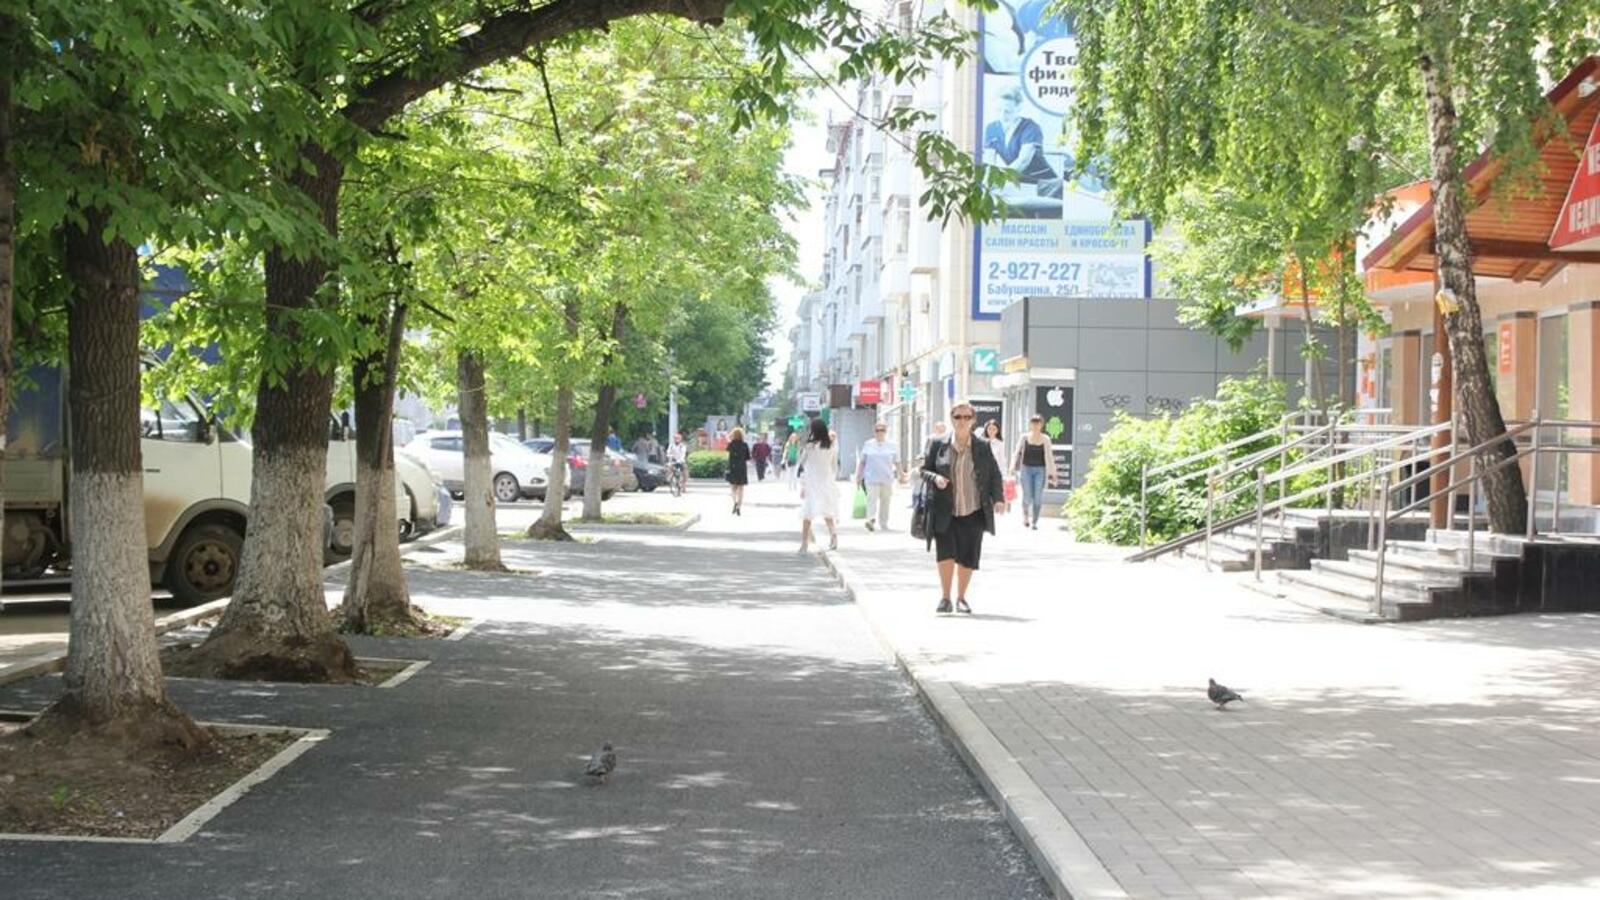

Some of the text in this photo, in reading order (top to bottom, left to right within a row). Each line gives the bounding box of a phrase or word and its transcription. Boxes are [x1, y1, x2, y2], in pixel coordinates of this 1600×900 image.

[1041, 51, 1078, 66] Тво
[1001, 224, 1048, 236] МАССАЖ
[985, 237, 1060, 249] САЛОН КРАСОТЫ
[988, 261, 1082, 281] 2-927-227
[974, 405, 1001, 413] ЕМОНТ
